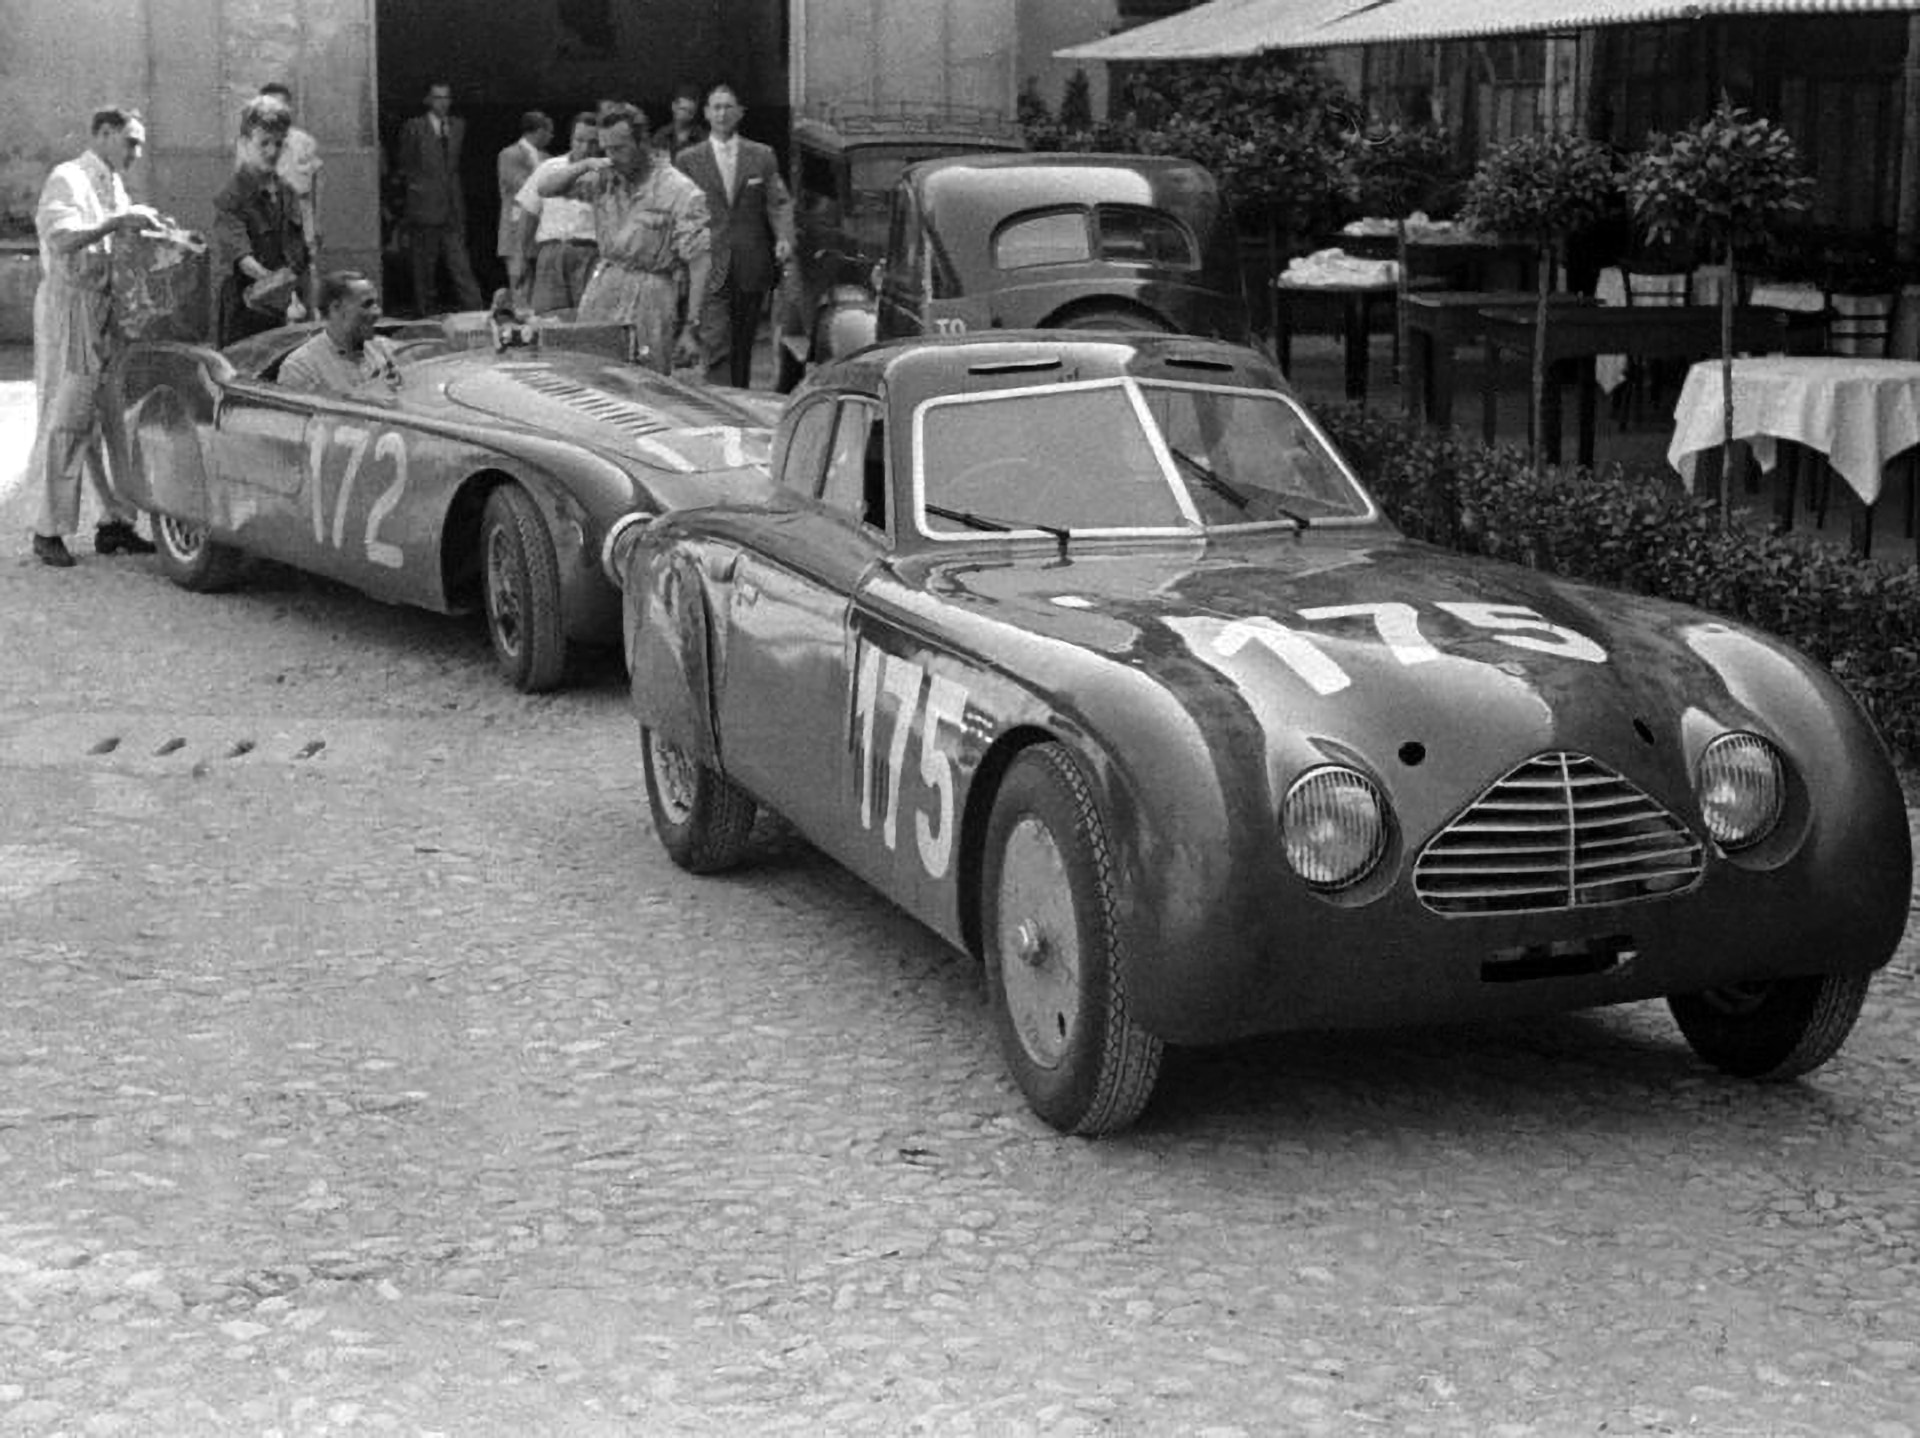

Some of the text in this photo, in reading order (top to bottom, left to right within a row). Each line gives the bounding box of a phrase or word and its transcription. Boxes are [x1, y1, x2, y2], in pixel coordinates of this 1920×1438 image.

[306, 423, 407, 568] 172
[1211, 602, 1608, 695] 175
[857, 648, 968, 878] 175
